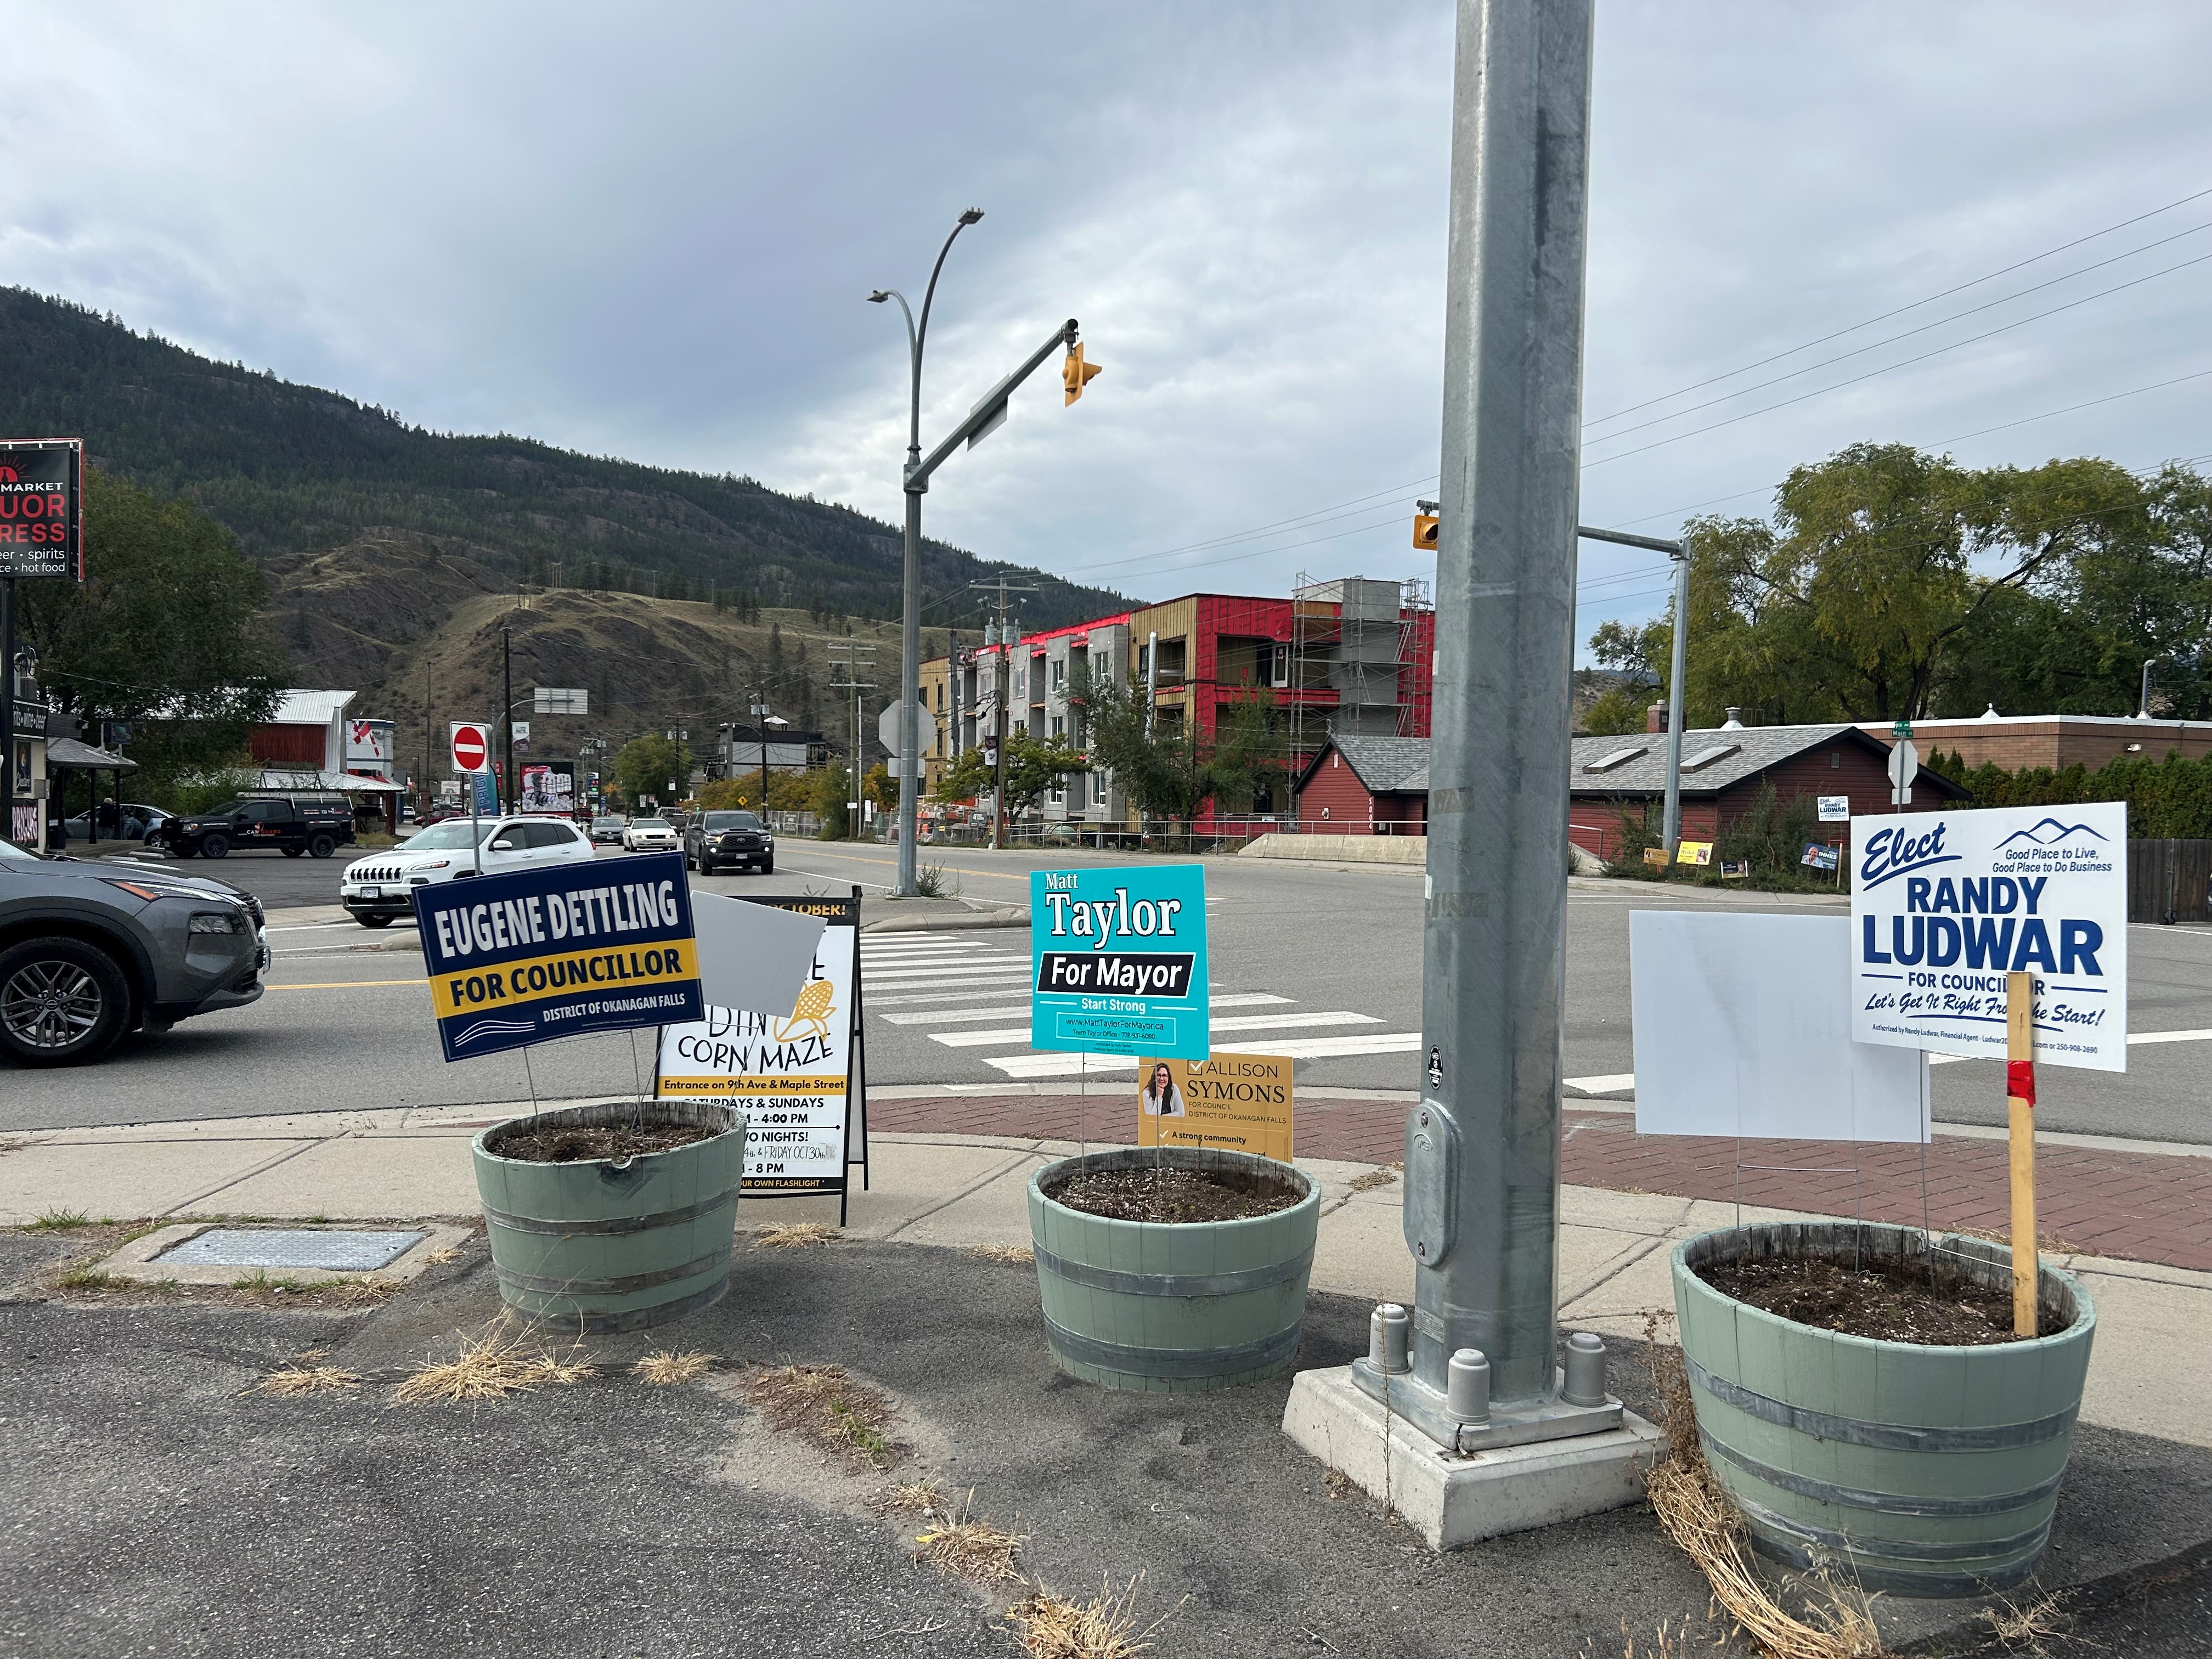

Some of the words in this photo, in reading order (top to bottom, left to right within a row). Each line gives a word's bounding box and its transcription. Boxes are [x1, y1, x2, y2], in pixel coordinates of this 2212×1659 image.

[1, 482, 63, 492] MARKET
[28, 548, 65, 562] spirits
[21, 563, 39, 573] hot
[41, 562, 65, 572] food
[475, 775, 490, 805] PRICI
[1819, 851, 1837, 860] INNES
[1861, 822, 1946, 881] Elect
[2006, 849, 2030, 860] Good
[2032, 848, 2059, 859] Place
[2062, 849, 2072, 859] to
[2075, 848, 2099, 860] Live,
[1993, 862, 2015, 872] Good
[2017, 862, 2040, 872] Place
[2043, 863, 2052, 872] to
[2055, 861, 2067, 872] Do
[2069, 861, 2112, 872] Business
[1045, 872, 1079, 890] Matt
[1908, 877, 2048, 915] RANDY
[768, 904, 845, 916] TOBER!
[435, 896, 545, 958] EUGENE
[546, 881, 679, 940] DETTLING
[1045, 887, 1182, 951] Taylor
[1863, 915, 2103, 976] LUDWAR
[450, 973, 505, 1006] FOR
[511, 949, 682, 994] COUNCILLOR
[1052, 957, 1092, 985] For
[1096, 958, 1183, 995] Mayor
[1908, 972, 1937, 988] FOR
[1941, 974, 2045, 996] COUNCILR
[543, 1003, 586, 1022] DISTRICT
[588, 1002, 601, 1014] OF
[602, 996, 657, 1013] OKANAGAN
[659, 993, 686, 1007] FALLS
[1081, 997, 1107, 1011] Start
[1109, 998, 1146, 1015] Strong
[1864, 993, 1896, 1011] Let's
[1899, 992, 1922, 1013] Get
[1926, 993, 1939, 1009] It
[1943, 994, 1981, 1015] Right
[1985, 997, 2007, 1015] Fro
[2032, 1001, 2047, 1019] he
[2051, 1004, 2105, 1026] Start!
[1066, 1019, 1164, 1030] www.MattTaylorForMayor.ca
[1872, 1024, 1897, 1032] Authorized
[1905, 1028, 1920, 1036] Randy
[1921, 1029, 1939, 1037] Ludwar,
[1940, 1031, 1962, 1040] Financial
[1963, 1033, 1978, 1042] Agent
[678, 1036, 748, 1073] CORN
[760, 1032, 833, 1074] MAZE
[1206, 1061, 1278, 1078] ALLISON
[664, 1080, 709, 1089] Entrance
[727, 1080, 744, 1089] 9th
[747, 1080, 766, 1089] Ave
[769, 1080, 778, 1089] &
[780, 1080, 811, 1091] Maple
[813, 1080, 844, 1089] Street
[1187, 1080, 1285, 1103] SYMONS
[756, 1098, 765, 1108] &
[768, 1098, 824, 1108] SUNDAYS
[761, 1114, 787, 1124] 4:00
[791, 1114, 808, 1124] PM
[1229, 1114, 1265, 1122] OKANAGAN
[761, 1132, 808, 1142] NIGHTS!
[1179, 1132, 1202, 1141] strong
[1204, 1135, 1246, 1145] community
[764, 1146, 792, 1159] FRIDAY
[794, 1146, 809, 1159] OCT
[809, 1147, 825, 1159] 30th
[756, 1163, 763, 1173] 8
[767, 1163, 784, 1173] PM
